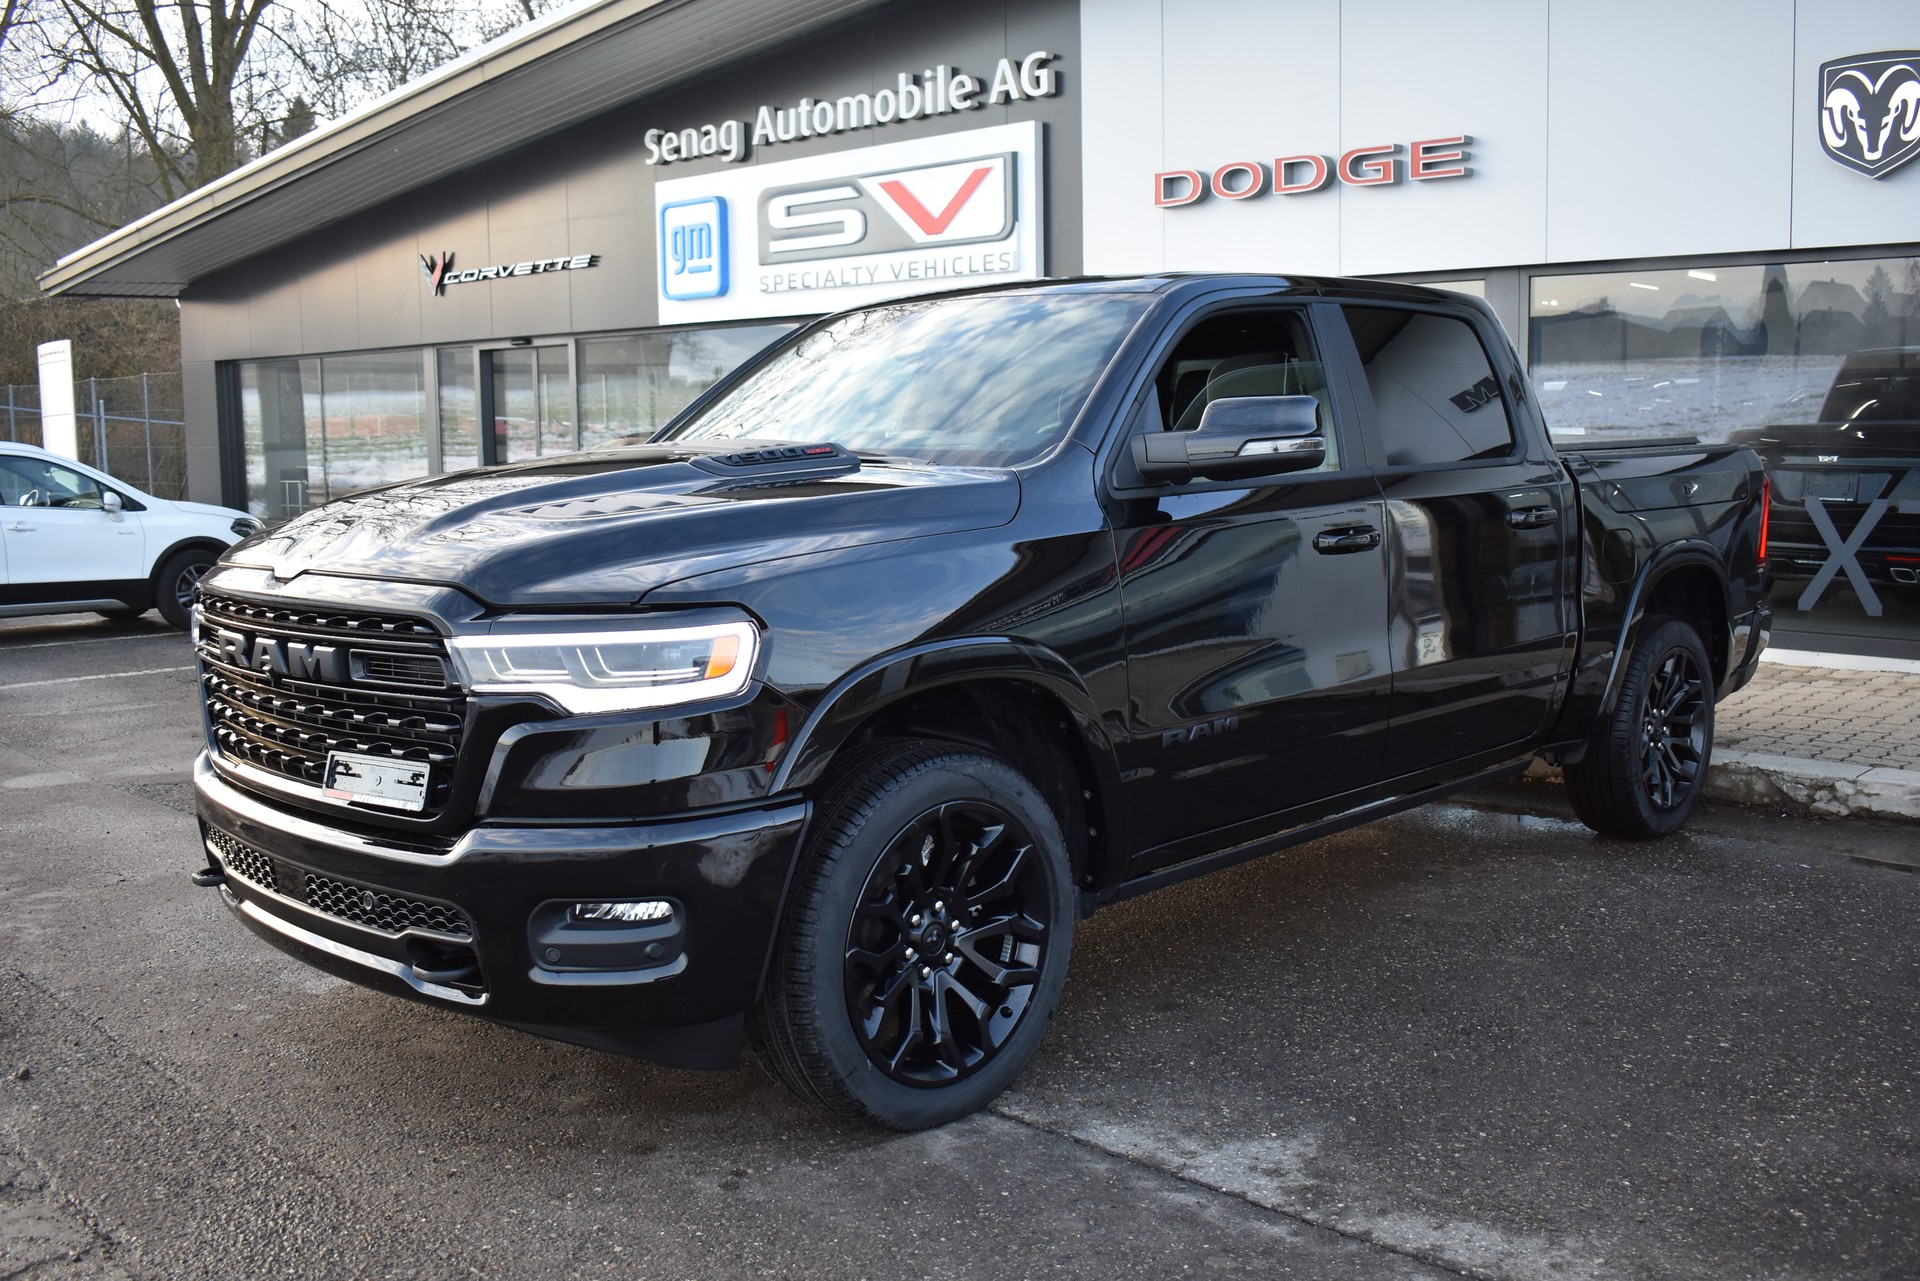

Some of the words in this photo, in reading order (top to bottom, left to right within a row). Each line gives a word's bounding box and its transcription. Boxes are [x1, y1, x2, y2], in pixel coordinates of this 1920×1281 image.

[644, 119, 743, 166] Senag
[752, 64, 978, 146] Automobile
[989, 51, 1054, 105] AG
[1154, 135, 1468, 208] DODGE
[443, 254, 593, 285] CORVETTE
[671, 221, 712, 275] gm
[759, 263, 879, 293] SPECIALTY
[890, 251, 1012, 280] VEHICLES
[726, 447, 803, 463] 1500
[1798, 496, 1920, 617] X
[218, 629, 340, 682] RAM
[1161, 715, 1239, 748] RAM
